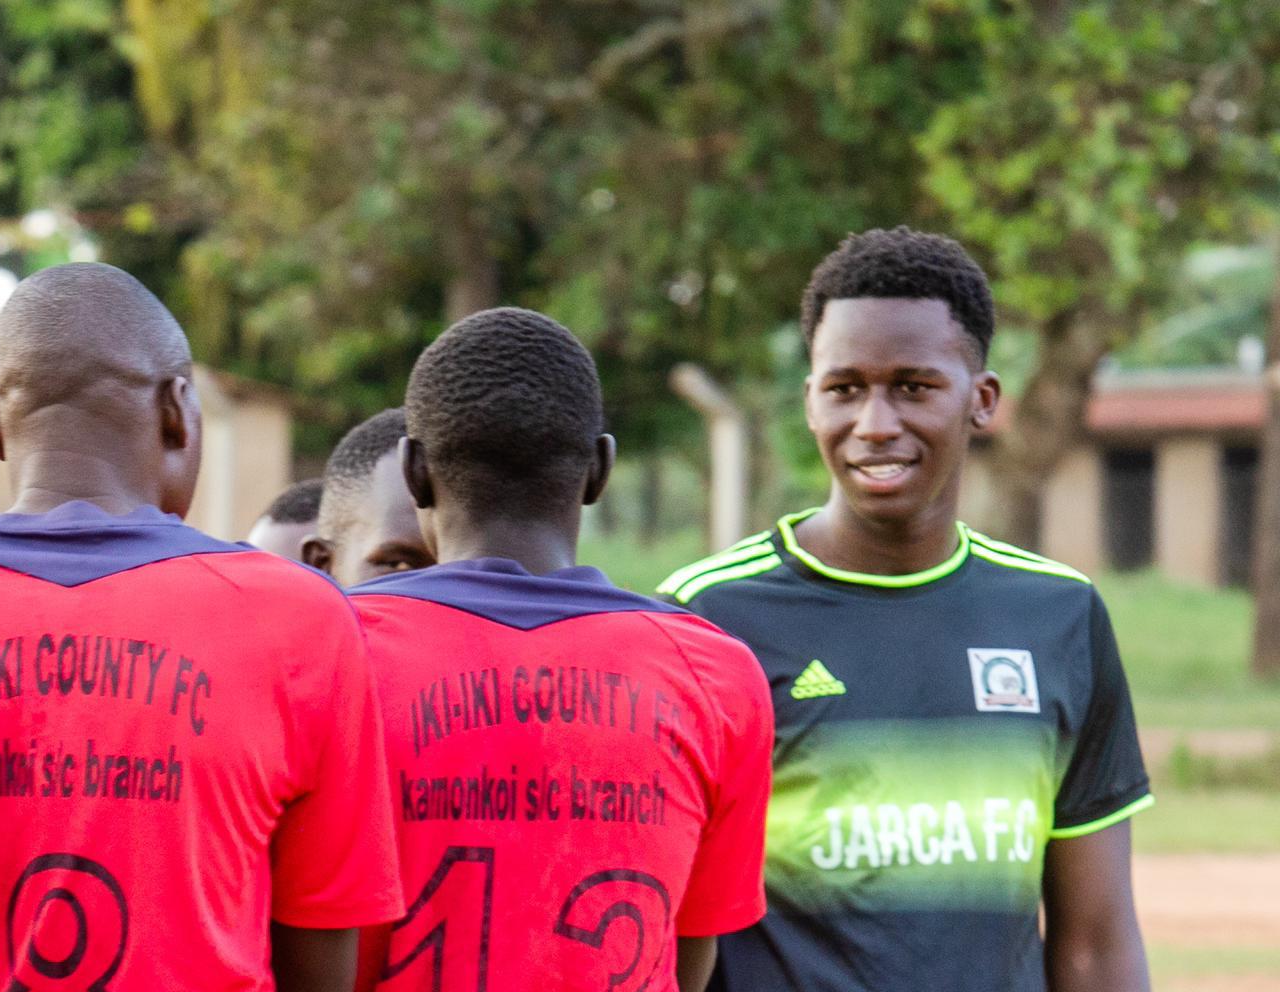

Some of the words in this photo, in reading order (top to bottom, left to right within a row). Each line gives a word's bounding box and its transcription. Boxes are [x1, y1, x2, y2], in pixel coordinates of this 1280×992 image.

[35, 633, 167, 705] COUNTY
[169, 655, 212, 736] FC
[412, 667, 501, 758] IKI-IKI
[511, 665, 642, 734] COUNTY
[83, 738, 182, 803] branch
[400, 764, 518, 823] kamonkoi
[525, 764, 561, 823] s/c
[571, 765, 666, 826] branch
[810, 800, 978, 871] JARCA
